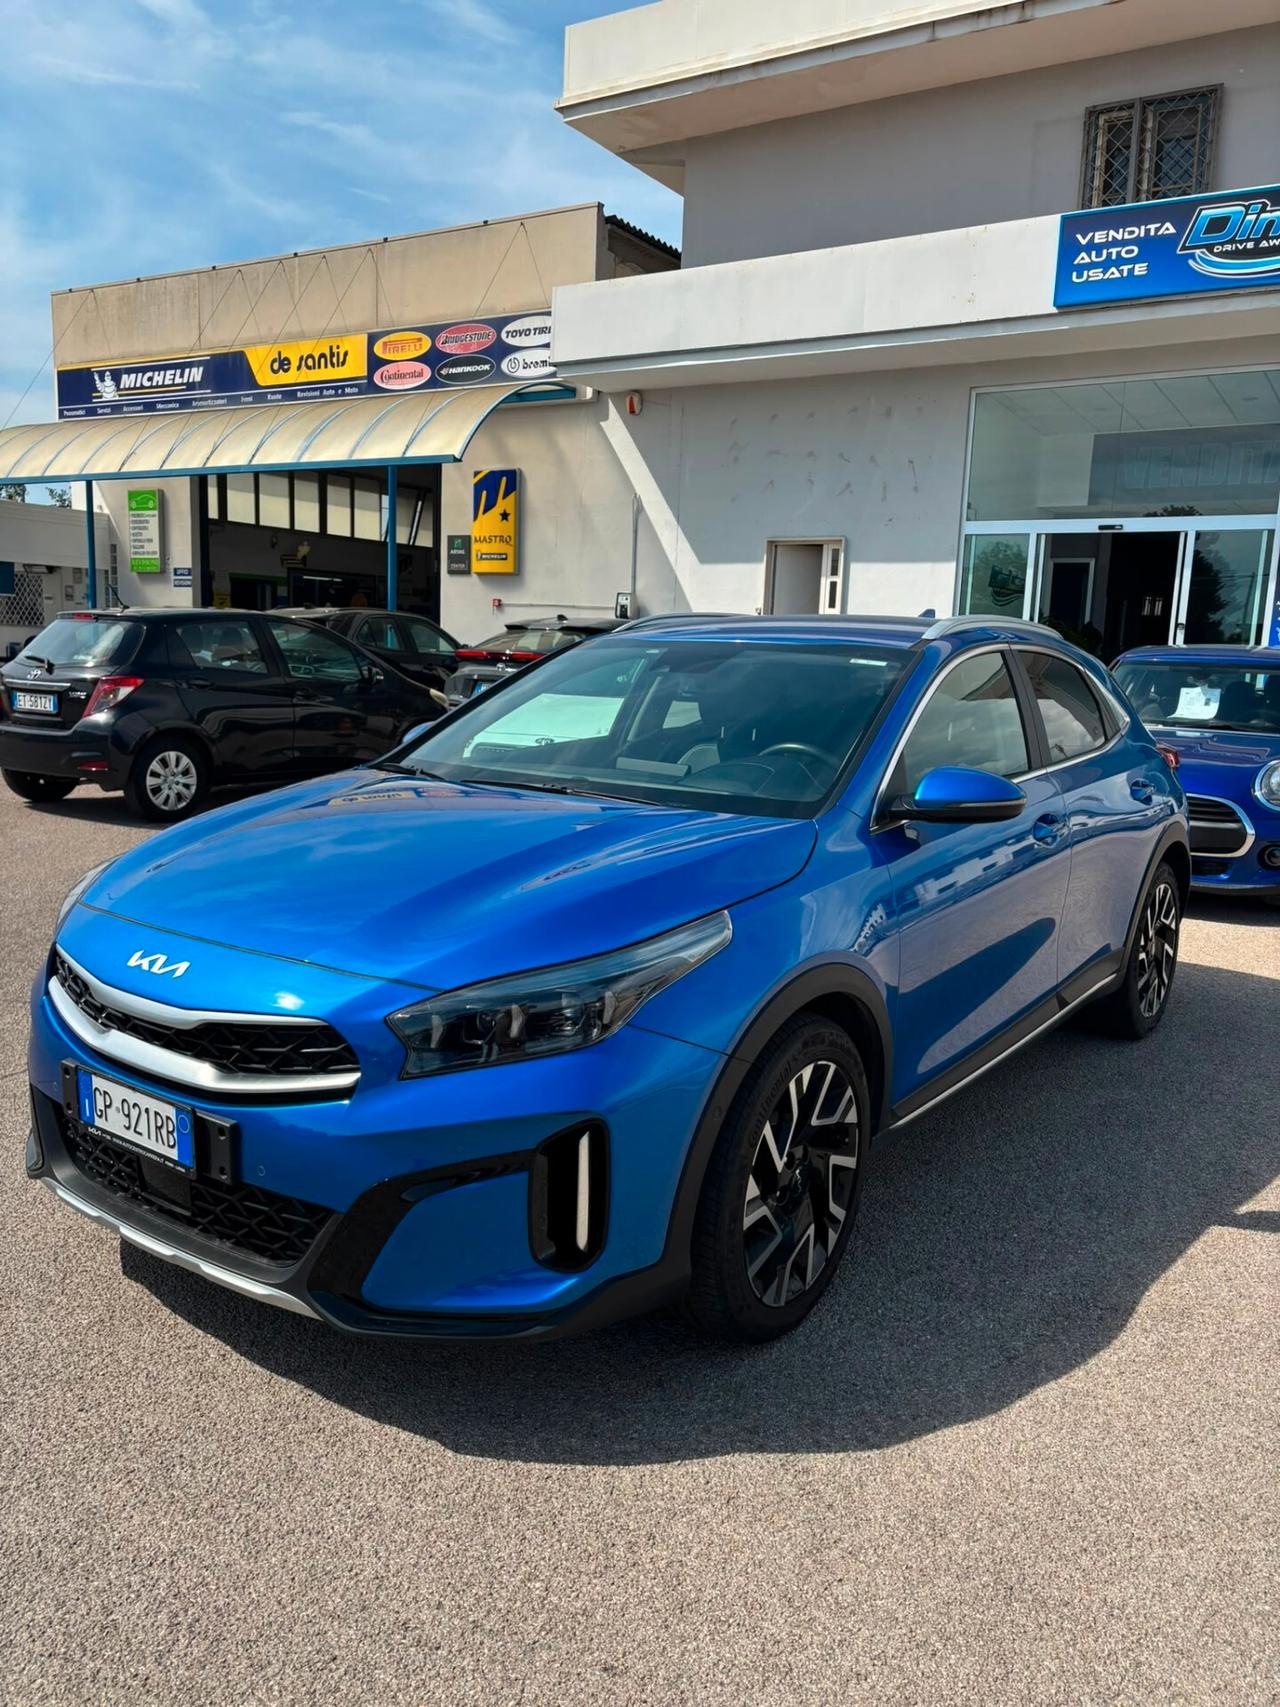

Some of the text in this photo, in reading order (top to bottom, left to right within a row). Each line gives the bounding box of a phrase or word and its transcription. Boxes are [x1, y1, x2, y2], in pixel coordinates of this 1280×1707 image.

[1075, 221, 1177, 246] VENDITA
[1072, 245, 1140, 265] AUTO
[1213, 241, 1255, 253] DRIVE
[1071, 262, 1149, 284] USATE
[440, 331, 492, 346] BRIDGESTONE
[504, 328, 532, 339] TOYO
[382, 337, 424, 355] PIRELLI
[270, 344, 349, 375] de santis
[522, 355, 551, 370] brem
[119, 367, 204, 389] MICHELIN
[380, 368, 424, 384] Continental
[473, 534, 513, 547] MASTRO
[17, 694, 27, 708] ET
[126, 949, 192, 979] KIA
[93, 1086, 177, 1150] GP 921RB
